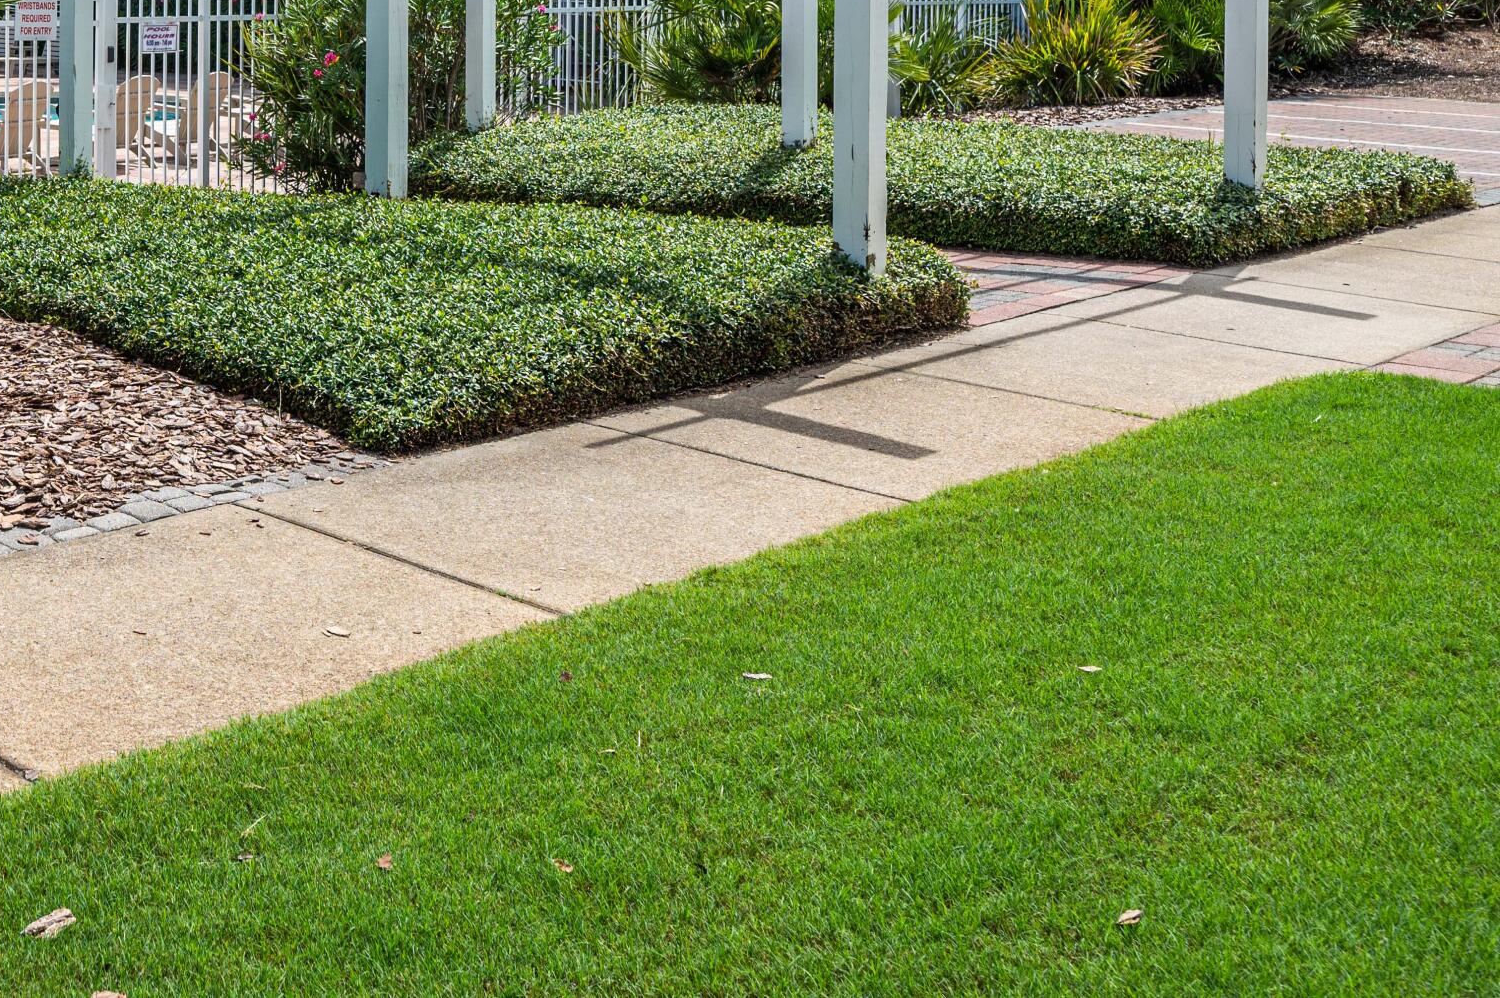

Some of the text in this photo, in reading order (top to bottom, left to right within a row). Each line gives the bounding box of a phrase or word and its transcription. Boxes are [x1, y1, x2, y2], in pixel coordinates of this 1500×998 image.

[17, 1, 56, 10] WRISTBANDS
[21, 14, 51, 23] REQUIRED
[20, 27, 52, 35] FOR ENTRY
